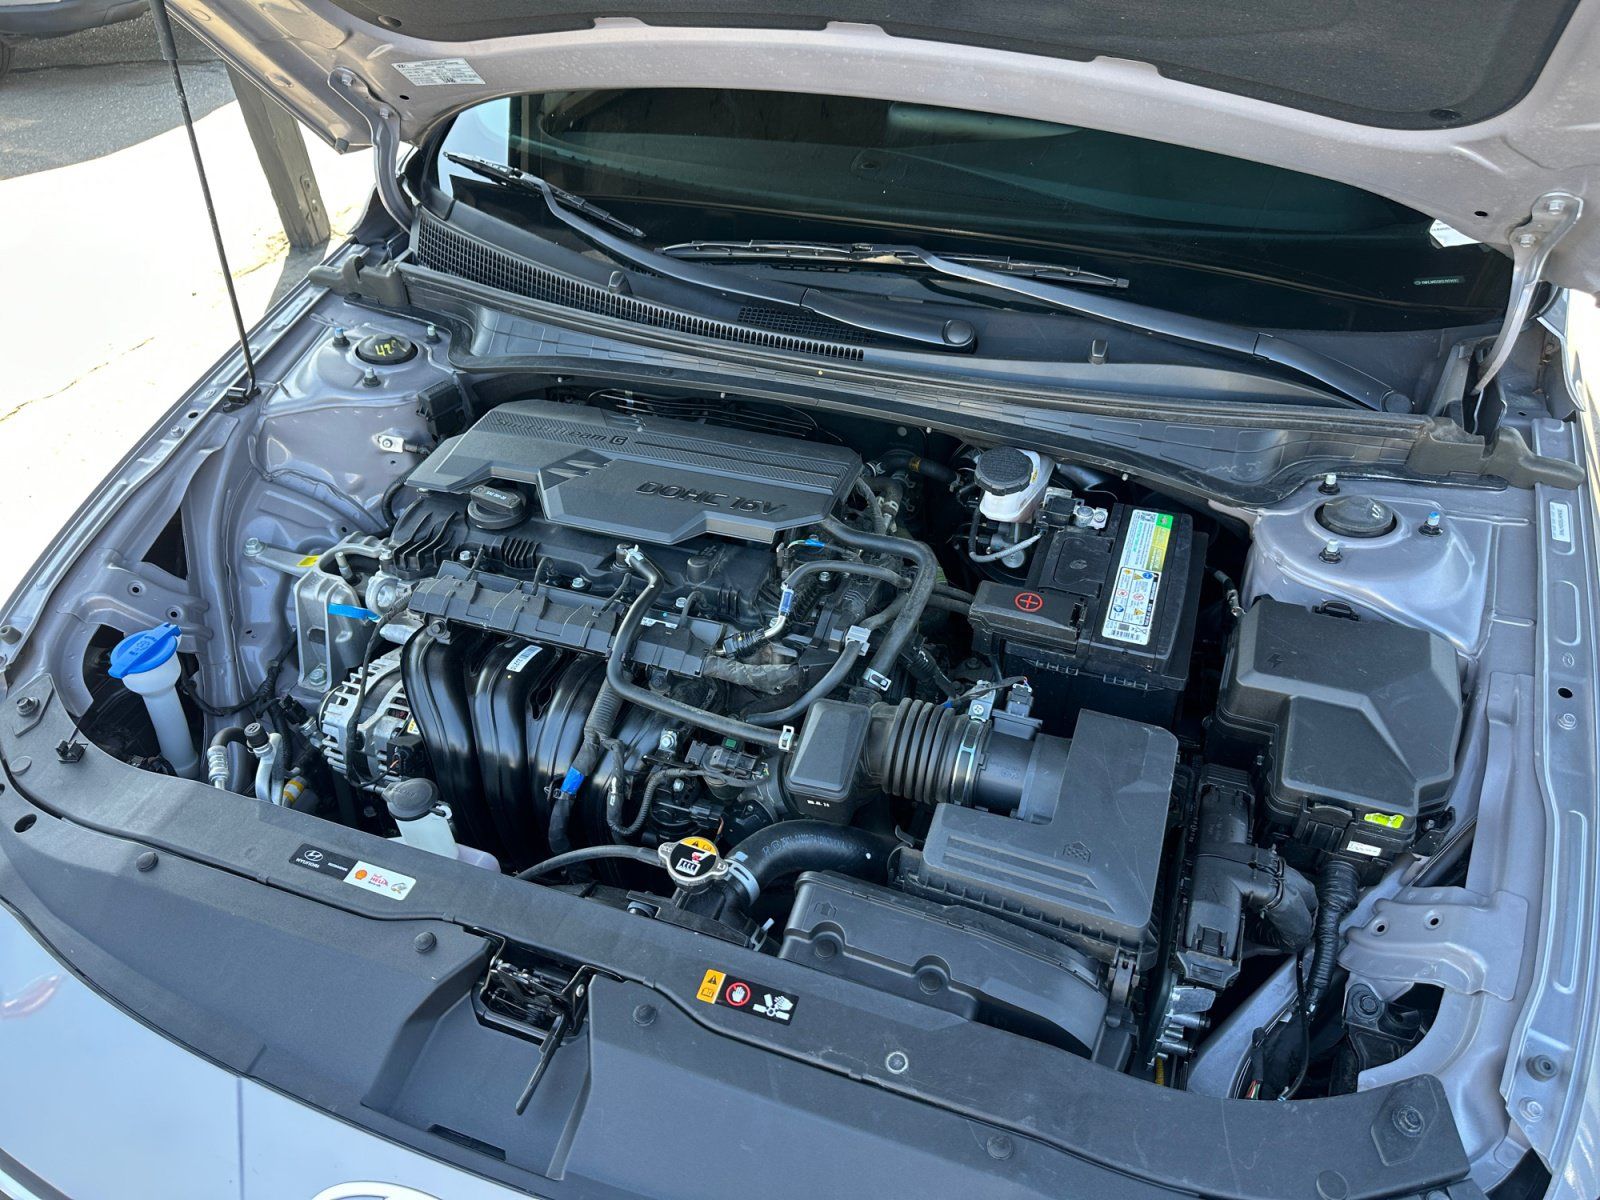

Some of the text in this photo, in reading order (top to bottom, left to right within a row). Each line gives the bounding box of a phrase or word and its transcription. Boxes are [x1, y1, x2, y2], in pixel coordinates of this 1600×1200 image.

[635, 480, 787, 515] DOHC 16V
[295, 857, 320, 869] HYUNDAI
